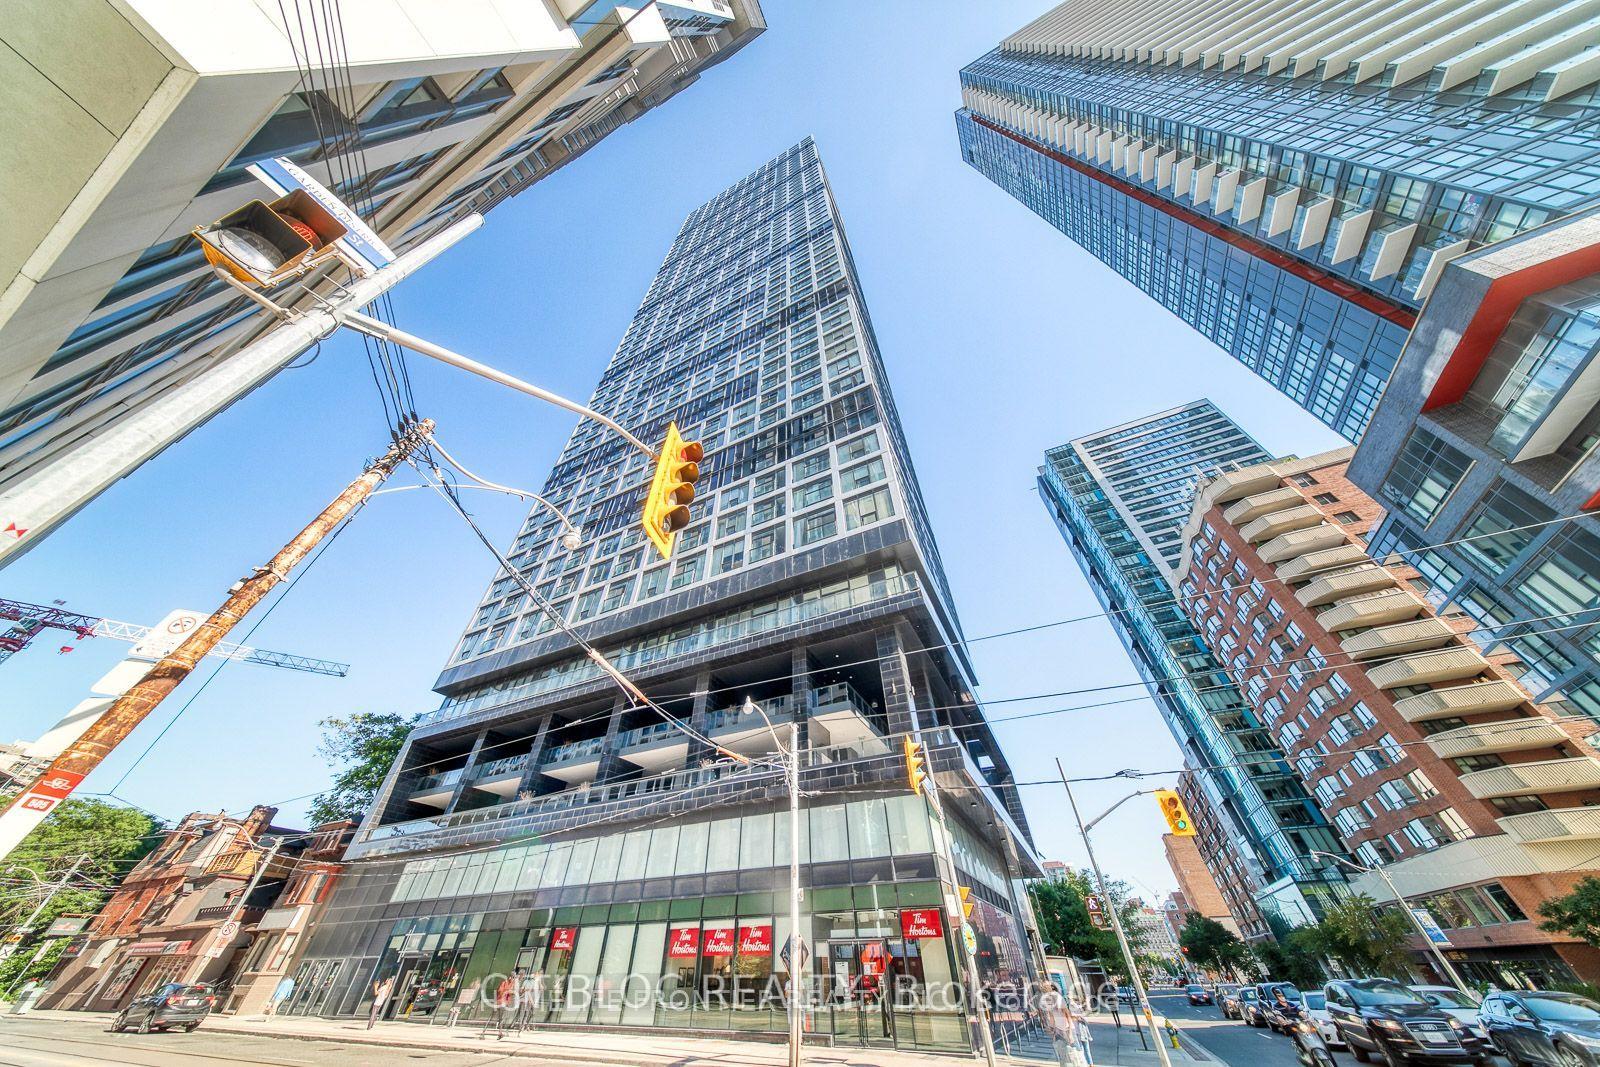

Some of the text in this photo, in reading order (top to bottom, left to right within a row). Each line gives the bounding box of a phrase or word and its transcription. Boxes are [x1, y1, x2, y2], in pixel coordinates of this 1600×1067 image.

[288, 167, 338, 210] GARDEN
[347, 234, 364, 247] St
[913, 913, 926, 924] Tim
[680, 929, 692, 941] Tim
[714, 929, 727, 939] Tim
[749, 926, 762, 938] Tim
[909, 924, 937, 936] Hortons
[671, 942, 697, 954] Hortons
[706, 939, 733, 953] Hortons
[741, 938, 770, 952] Hortons
